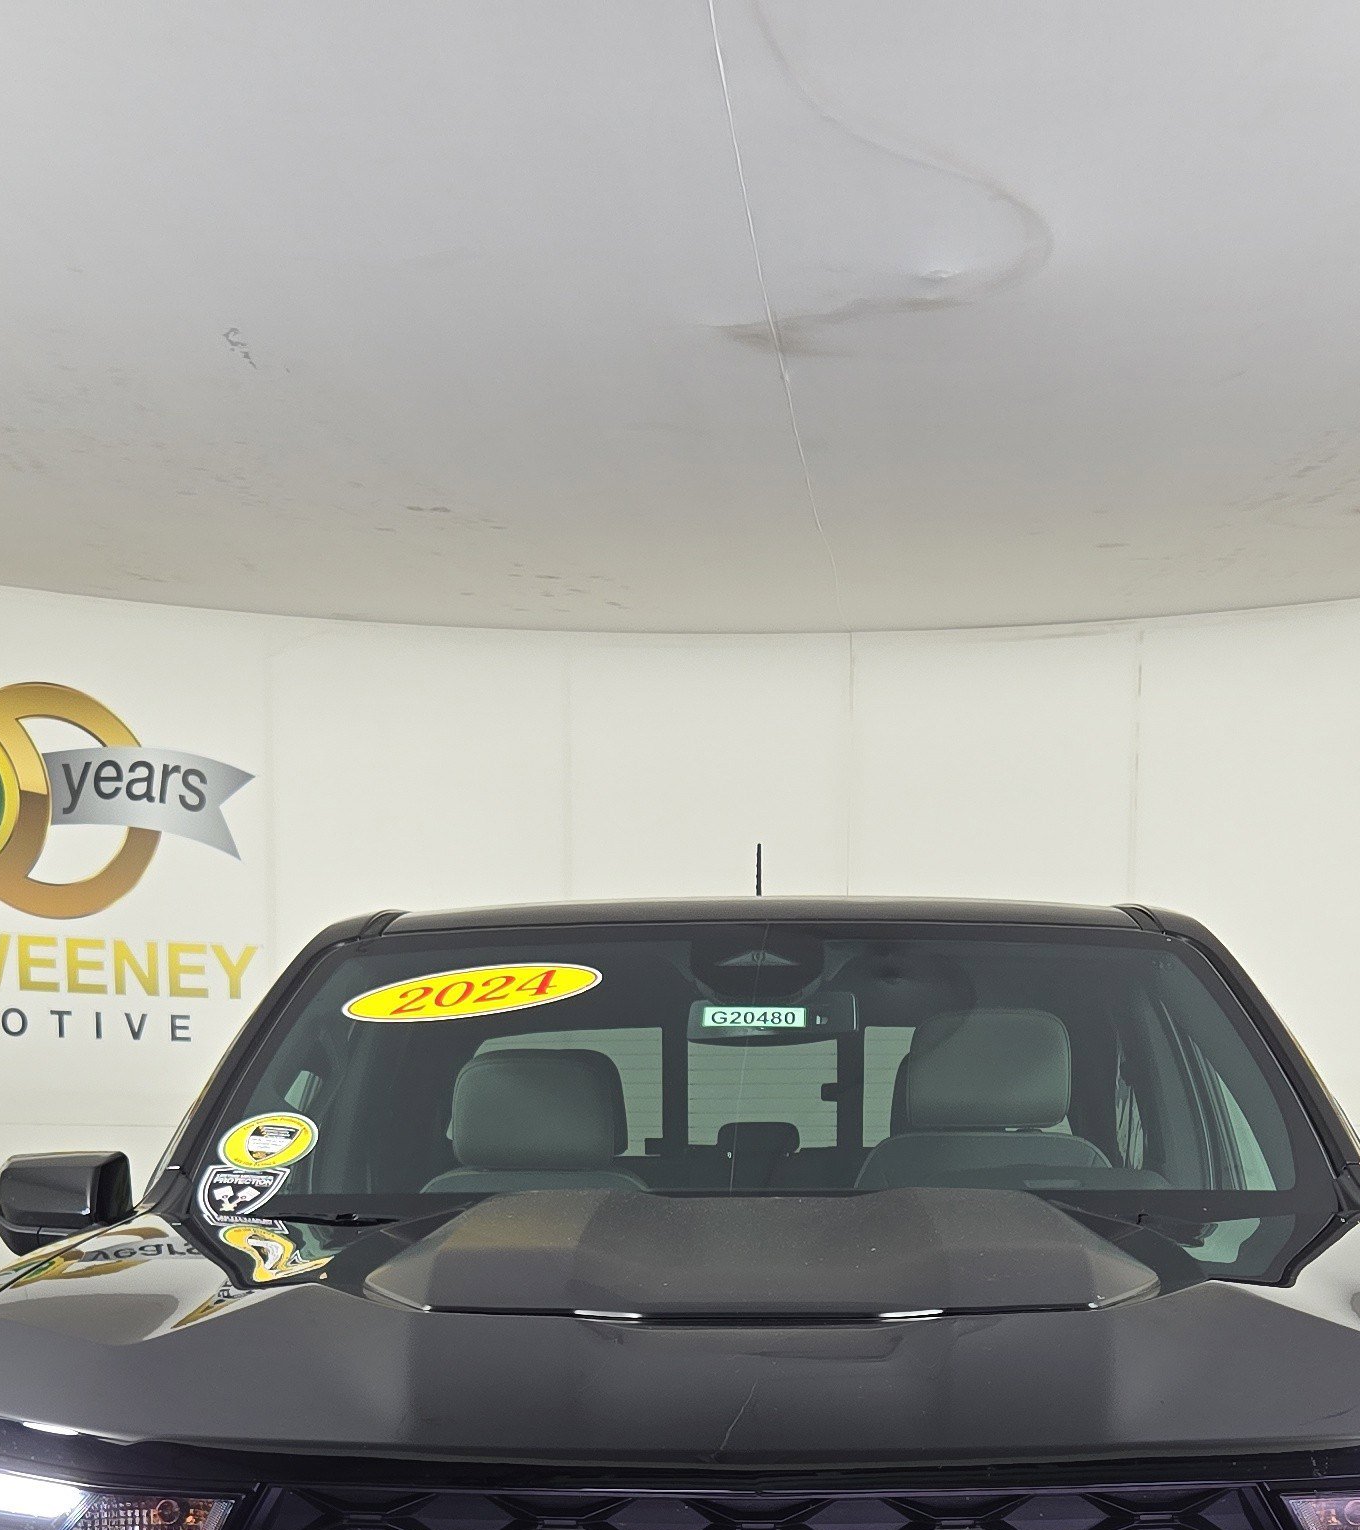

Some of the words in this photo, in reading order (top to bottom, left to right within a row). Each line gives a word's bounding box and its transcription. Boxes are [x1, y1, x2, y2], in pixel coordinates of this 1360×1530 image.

[61, 759, 208, 815] years
[390, 970, 557, 1015] 2024
[711, 1011, 796, 1025] G20480
